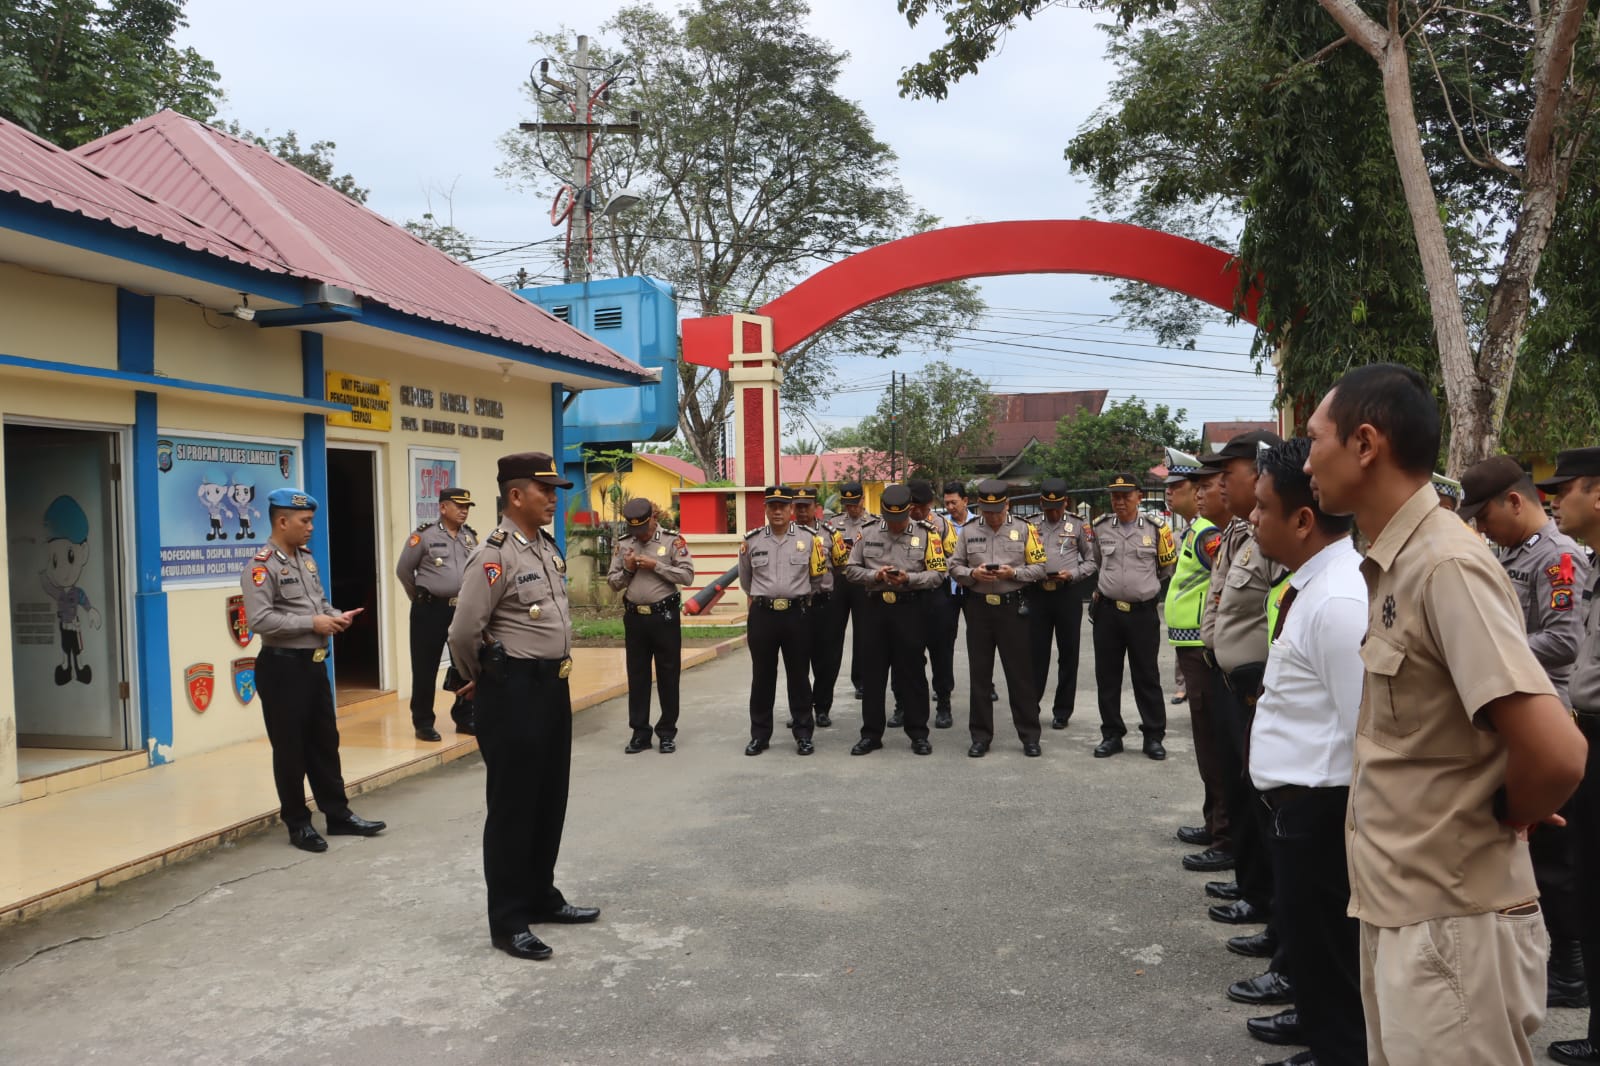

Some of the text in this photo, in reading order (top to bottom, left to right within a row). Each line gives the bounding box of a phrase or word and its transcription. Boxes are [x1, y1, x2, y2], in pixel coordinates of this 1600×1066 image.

[177, 444, 277, 466] SI PROPAM POLRES LANGKAT
[206, 562, 227, 575] POLISI
